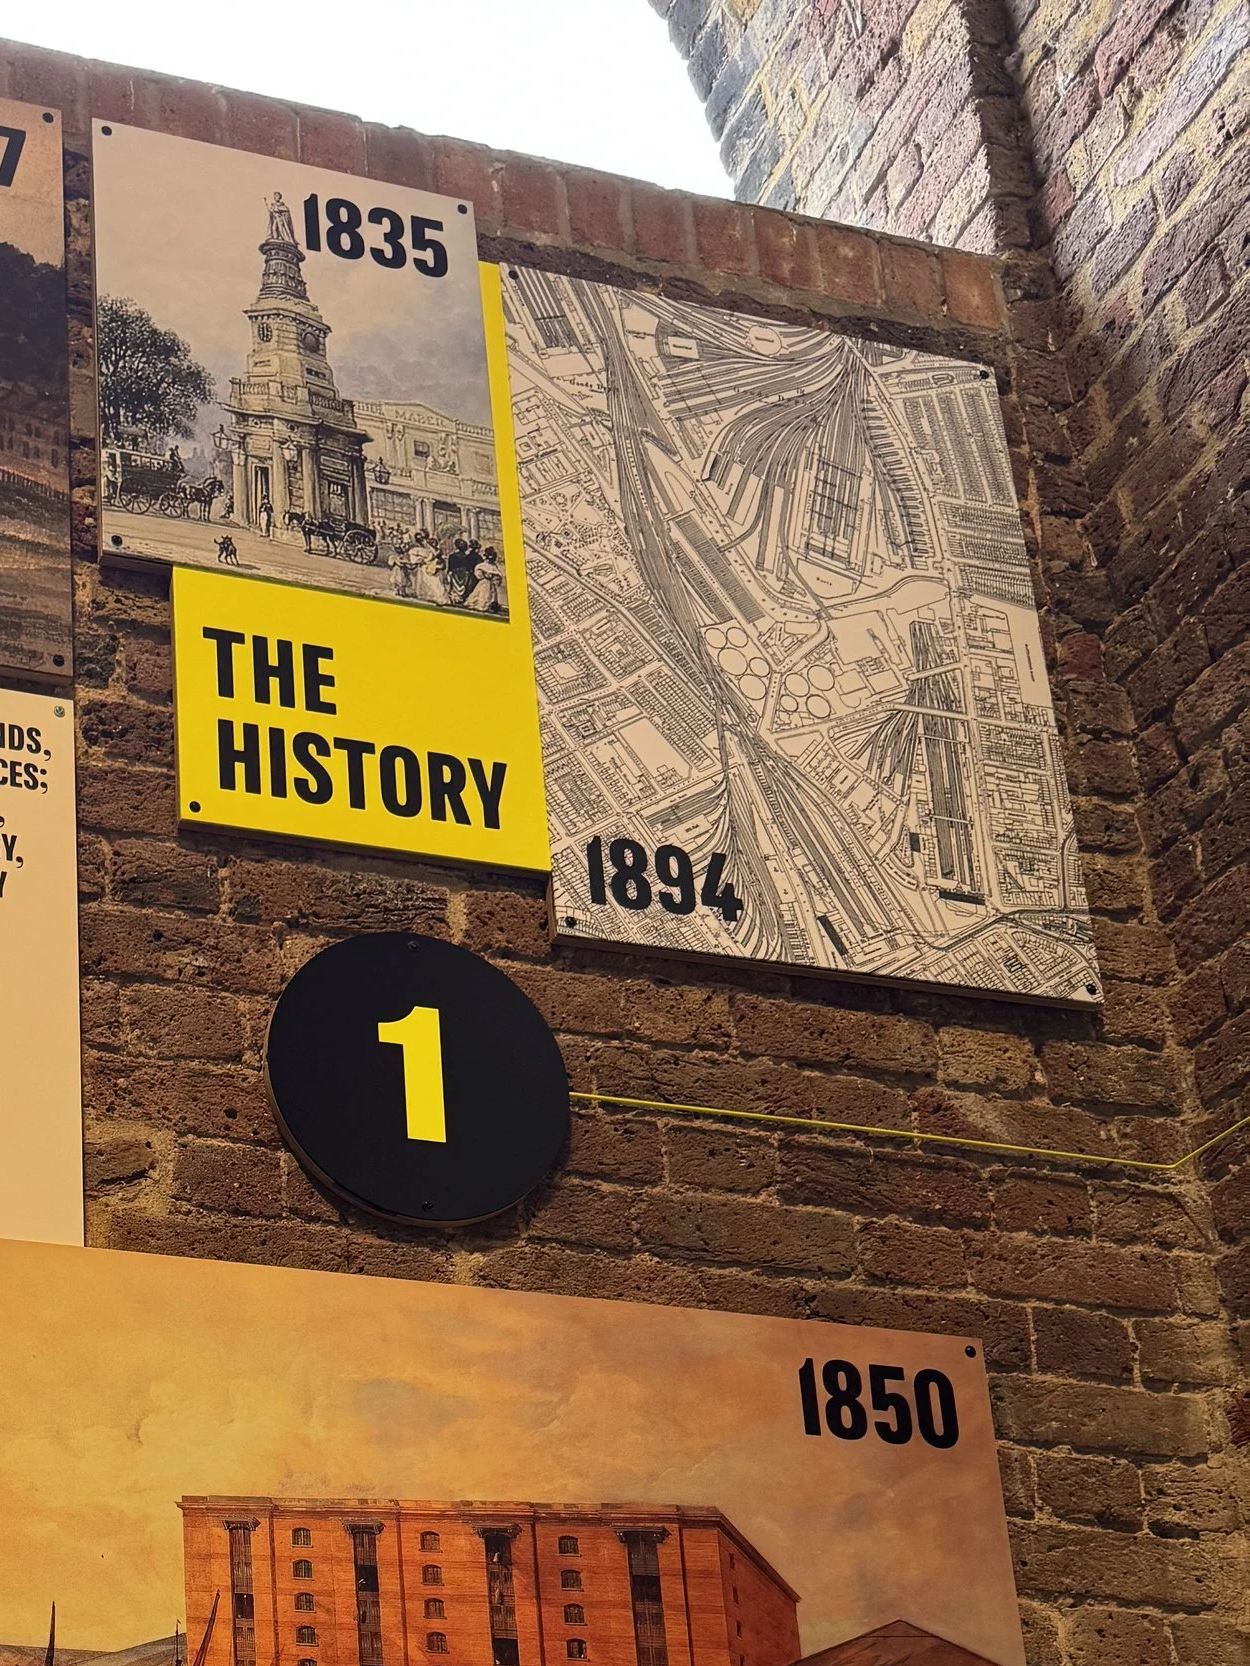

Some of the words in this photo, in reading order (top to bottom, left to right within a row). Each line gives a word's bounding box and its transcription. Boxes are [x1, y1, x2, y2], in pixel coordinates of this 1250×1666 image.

[303, 193, 449, 278] 1835
[203, 626, 337, 715] THE
[218, 718, 508, 830] HISTORY
[586, 835, 745, 923] 1894
[378, 1006, 447, 1143] 1
[798, 1357, 959, 1449] 1850
